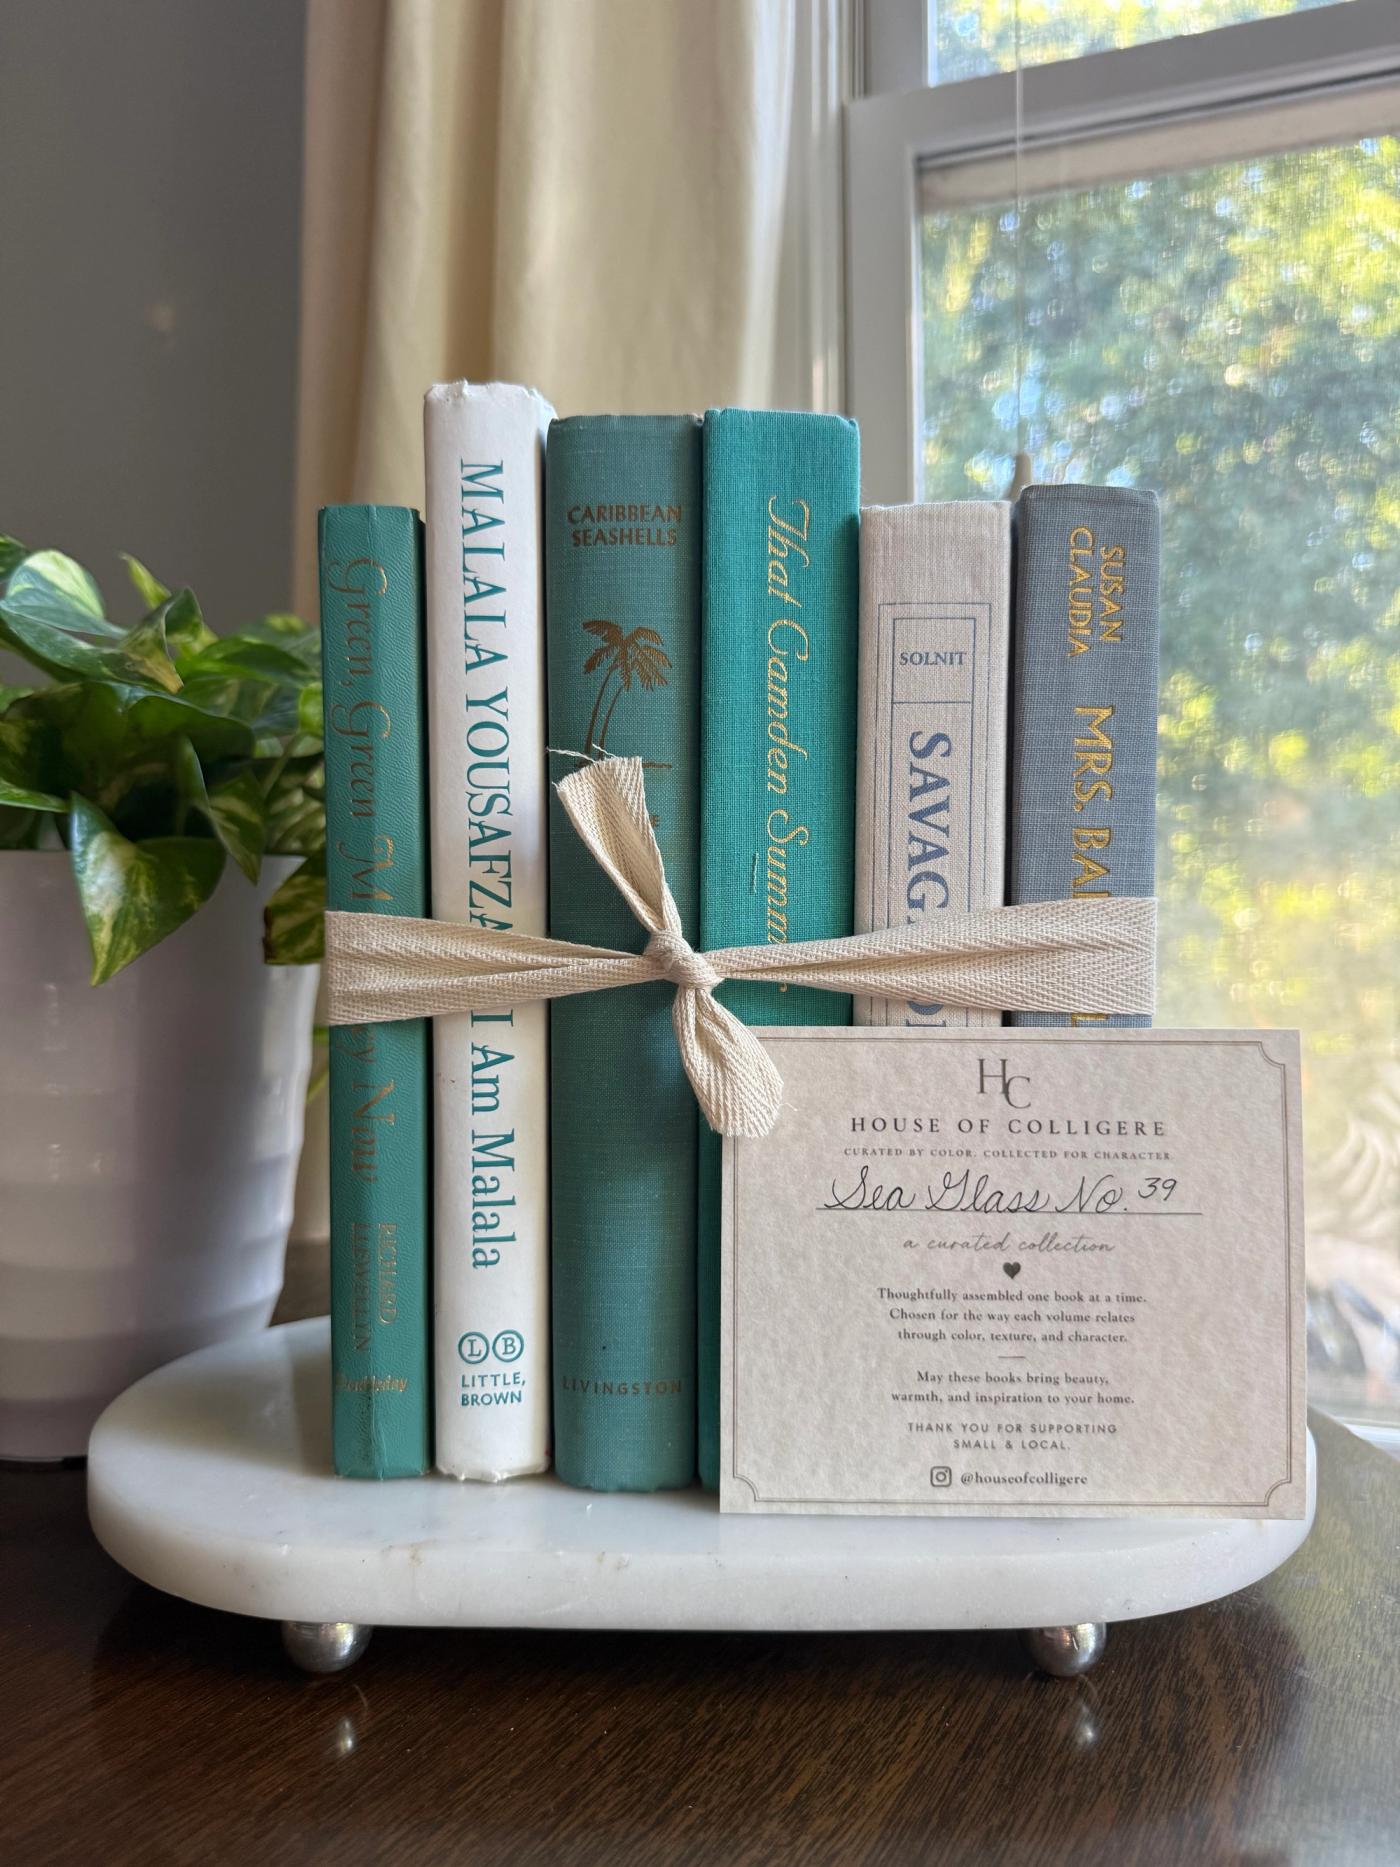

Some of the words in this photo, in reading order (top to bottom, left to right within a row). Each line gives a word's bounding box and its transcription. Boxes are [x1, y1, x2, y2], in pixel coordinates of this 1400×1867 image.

[567, 503, 682, 526] CARIBBEAN
[572, 527, 678, 547] SEASHELLS
[767, 495, 810, 608] That
[460, 458, 508, 676] MALALA
[1067, 527, 1095, 658] CLAUDIA
[1099, 545, 1127, 643] SUSAN
[899, 650, 968, 667] SOLNIT
[767, 618, 809, 795] Camden
[332, 699, 392, 818] Green
[1071, 705, 1115, 812] MRS.
[465, 686, 514, 930] YOUSAFZA
[905, 730, 953, 924] SAVAG
[471, 1041, 516, 1117] Am
[351, 1080, 396, 1184] Now
[851, 1117, 940, 1133] HOUSE
[958, 1118, 990, 1134] OF
[1008, 1119, 1165, 1136] COLLIGERE
[844, 1147, 903, 1157] CURATED
[909, 1148, 924, 1158] BY
[983, 1149, 1057, 1159] COLLECTED
[1064, 1150, 1088, 1160] FOR
[471, 1128, 517, 1270] Malala
[824, 1165, 916, 1211] Sea
[925, 1168, 1050, 1214] Glass
[1054, 1174, 1128, 1214] No.
[1137, 1177, 1178, 1201] 39
[903, 1239, 919, 1250] a
[927, 1231, 1011, 1251] curated
[1018, 1231, 1116, 1253] collection
[378, 1222, 398, 1325] RICHARD
[877, 1287, 958, 1302] Thoughtfully
[962, 1290, 1023, 1301] assembled
[1027, 1293, 1050, 1302] one
[1054, 1290, 1084, 1302] book
[1088, 1293, 1101, 1303] at
[1104, 1294, 1111, 1303] a
[1116, 1293, 1147, 1303] time.
[889, 1307, 936, 1320] Chosen
[941, 1309, 959, 1321] for
[963, 1309, 983, 1321] the
[987, 1313, 1010, 1324] way
[1014, 1310, 1041, 1322] each
[1046, 1310, 1091, 1323] volume
[1095, 1311, 1136, 1323] relates
[898, 1328, 946, 1342] through
[951, 1329, 985, 1342] color,
[990, 1331, 1037, 1343] texture,
[1041, 1330, 1064, 1342] and
[1067, 1330, 1128, 1343] character.
[461, 1371, 526, 1388] LITTLE,
[562, 1375, 683, 1395] LIVINGSTON
[917, 1370, 943, 1384] May
[948, 1371, 981, 1383] these
[985, 1371, 1022, 1384] books
[1026, 1372, 1060, 1386] bring
[461, 1390, 522, 1406] BROWN
[891, 1391, 943, 1403] warmth,
[947, 1391, 971, 1403] and
[975, 1391, 1042, 1406] inspiration
[1047, 1394, 1060, 1404] to
[1064, 1395, 1093, 1406] your
[1097, 1392, 1135, 1404] home.
[908, 1422, 953, 1433] THANK
[961, 1422, 989, 1433] YOU
[997, 1423, 1022, 1434] FOR
[1030, 1424, 1117, 1434] SUPPORTING
[953, 1439, 996, 1449] SMALL
[1004, 1440, 1013, 1450] &
[1021, 1440, 1071, 1450] LOCAL.
[960, 1471, 1088, 1487] @houseofcolligere
